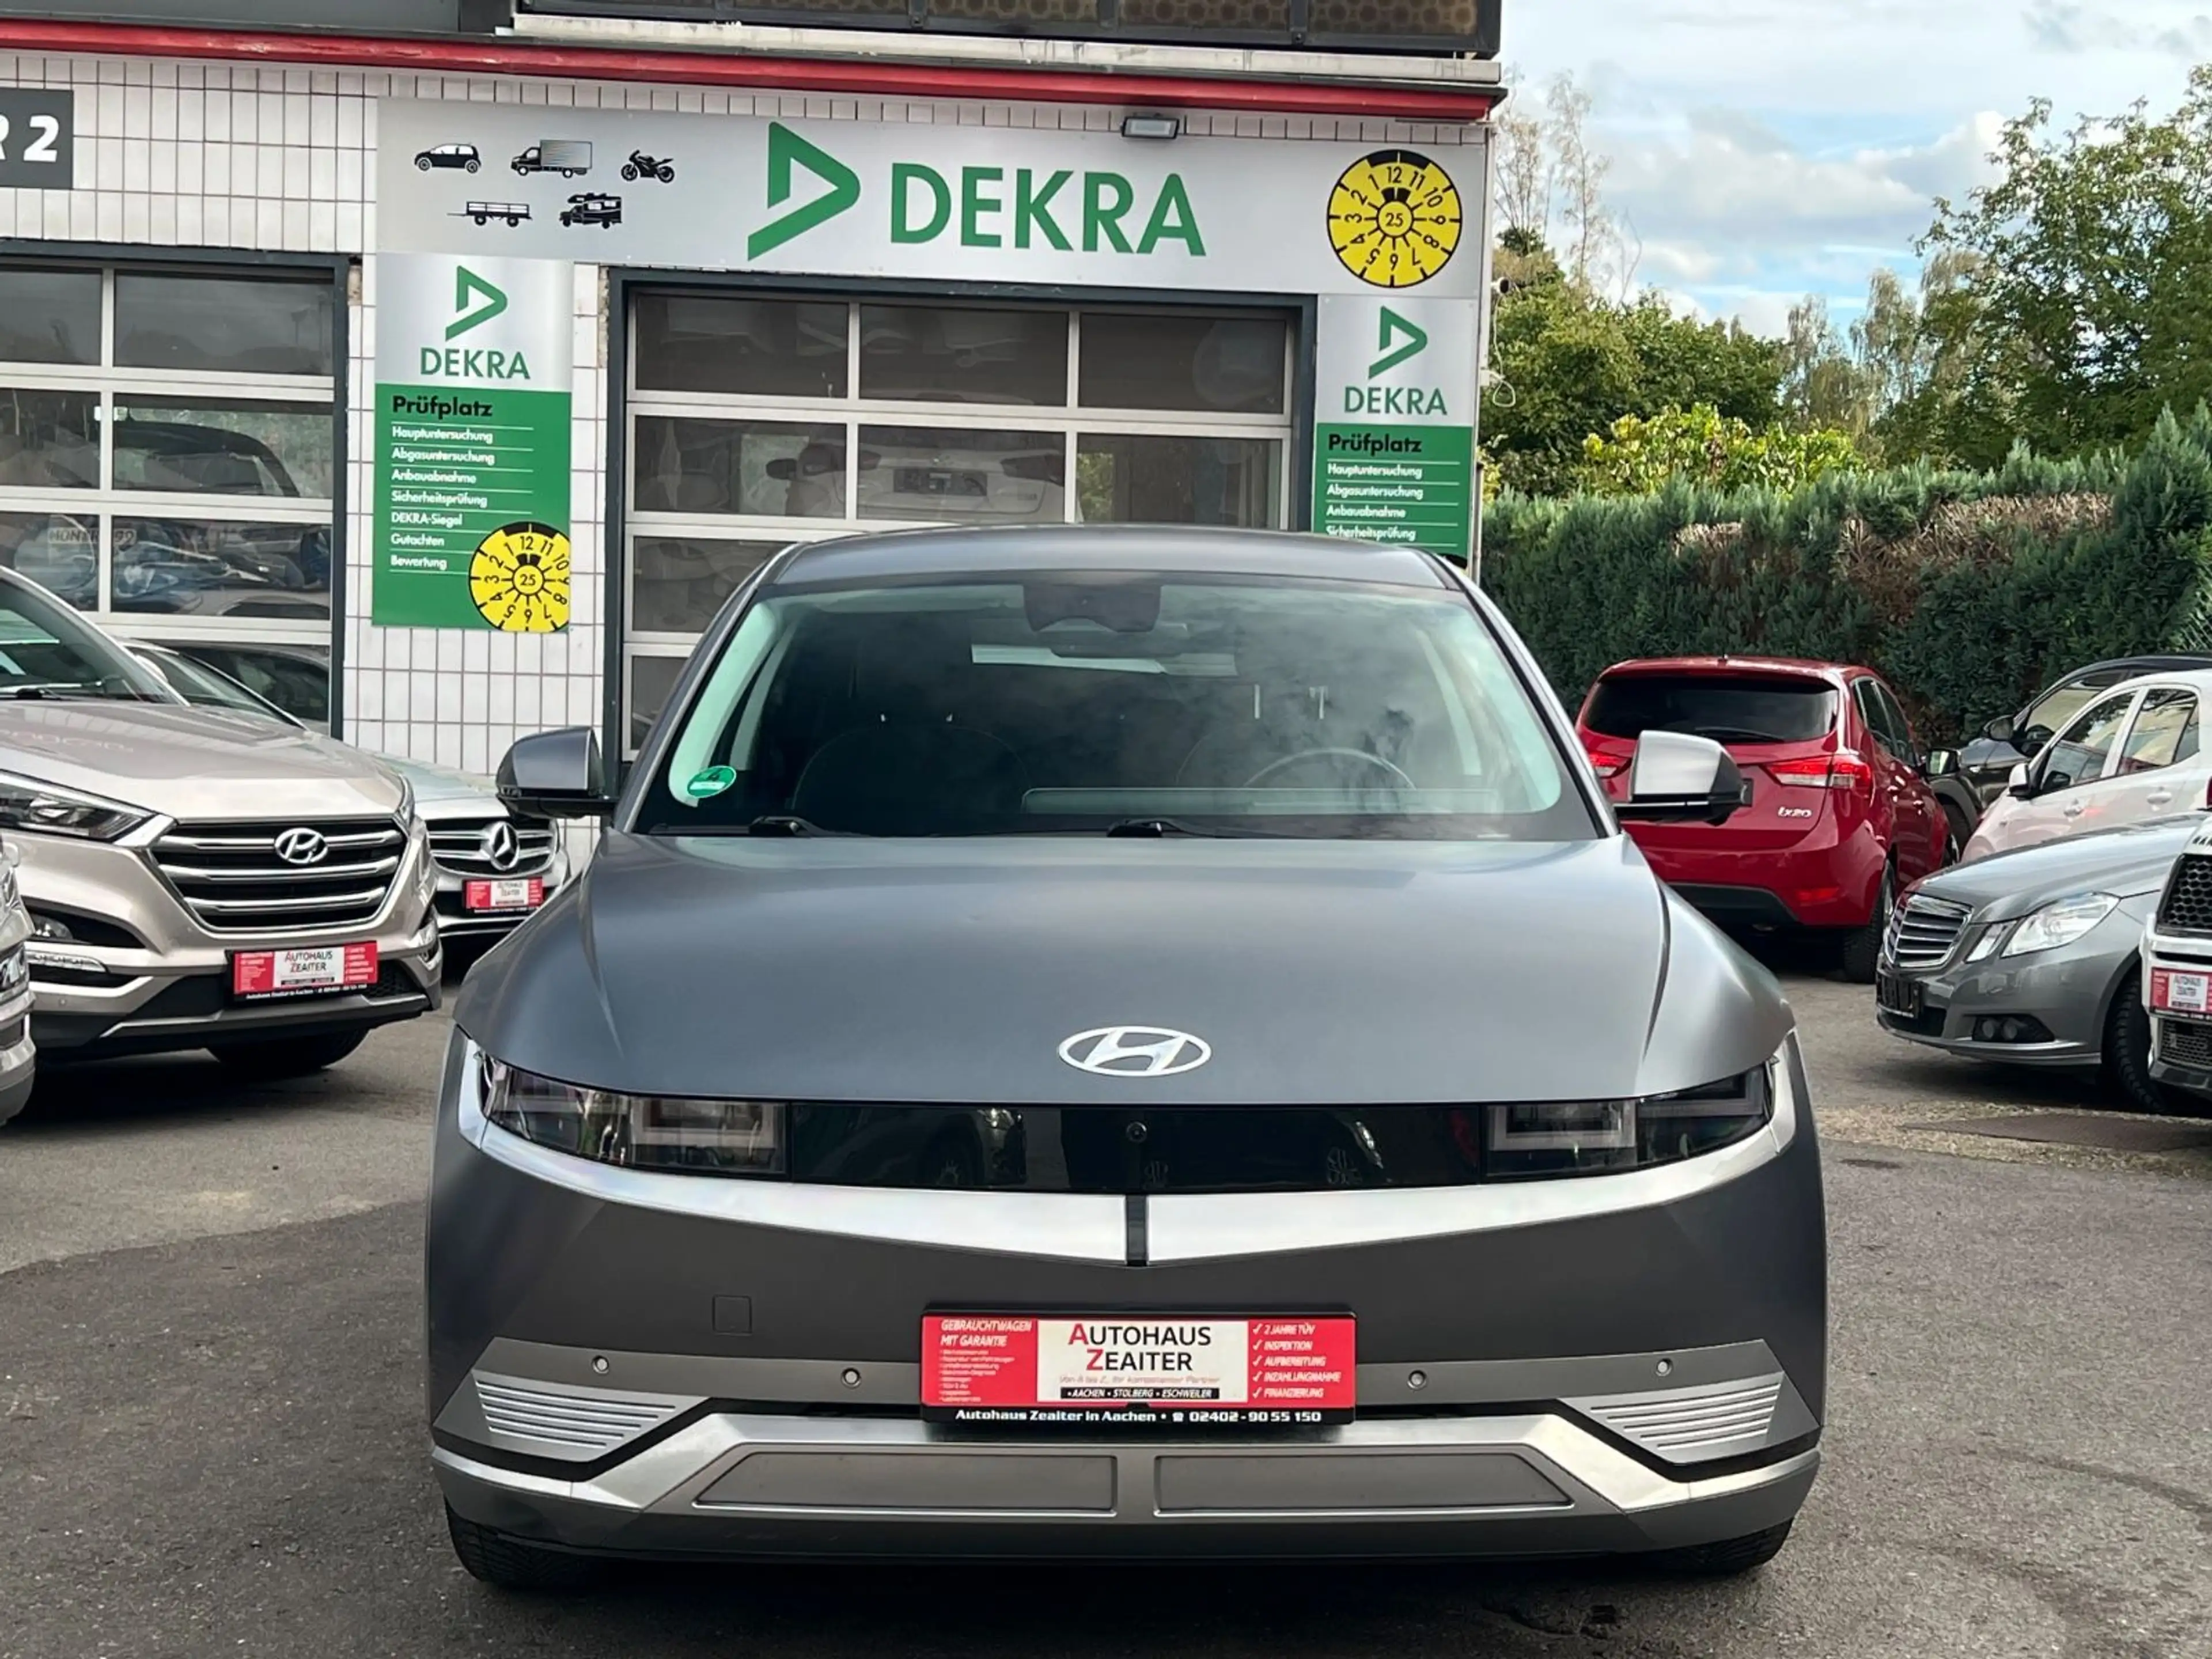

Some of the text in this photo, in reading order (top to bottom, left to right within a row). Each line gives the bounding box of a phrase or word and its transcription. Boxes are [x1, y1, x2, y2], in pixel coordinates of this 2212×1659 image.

[24, 115, 59, 162] 2
[1368, 173, 1380, 191] 1
[1387, 166, 1402, 184] 12
[1410, 170, 1426, 191] 11
[1350, 190, 1368, 206] 2
[1423, 187, 1443, 207] 10
[891, 162, 1207, 256] DEKRA
[1344, 213, 1362, 223] 3
[1385, 213, 1404, 228] 25
[1349, 234, 1365, 244] 4
[1423, 234, 1440, 249] 8
[1366, 248, 1380, 265] 5
[1412, 247, 1421, 266] 7
[420, 347, 531, 380] DEKRA
[393, 395, 493, 419] Prüfplatz
[1344, 386, 1448, 415] DEKRA
[392, 426, 493, 444] Hauptuntersuchung
[1328, 433, 1422, 457] Prüfplatz
[392, 447, 495, 466] Abgasuntersuchung
[391, 469, 477, 484] Anbauabnahme
[1327, 463, 1422, 480] Hauptuntersuchung
[391, 491, 488, 508] Sicherheitsprüfung
[1327, 484, 1423, 500] Abgasuntersuchung
[1326, 505, 1406, 518] Anbauabnahme
[391, 512, 463, 529] DEKRA-Siegel
[391, 533, 445, 547] Gutachten
[1326, 525, 1416, 541] Sicherheitsprüfung
[503, 541, 514, 556] 1
[520, 536, 534, 550] 12
[540, 539, 554, 556] 11
[391, 555, 448, 570] Bewertung
[490, 555, 504, 568] 2
[552, 553, 569, 571] 10
[484, 575, 499, 584] 3
[520, 574, 536, 586] 25
[489, 592, 503, 601] 4
[553, 592, 568, 605] 8
[503, 605, 516, 619] 5
[543, 604, 552, 620] 7
[285, 950, 333, 962] AUTOHAUS
[941, 1319, 1032, 1331] GEBRAUCHTWAGEN
[1270, 1324, 1297, 1335] JAHRE
[940, 1334, 1007, 1347] MIT GARANTIE
[1068, 1323, 1211, 1346] AUTOHAUS
[1264, 1340, 1313, 1351] INSPEKTION
[1086, 1349, 1193, 1371] ZEAITER
[1264, 1356, 1327, 1367] AUFBEREITUNG
[1264, 1387, 1325, 1398] FINANZIERUNG
[956, 1410, 1027, 1421] Autohaus
[1030, 1411, 1081, 1421] Zeaiter
[1085, 1411, 1100, 1421] in
[1101, 1411, 1156, 1422] Aachen
[1294, 1411, 1321, 1422] 150
